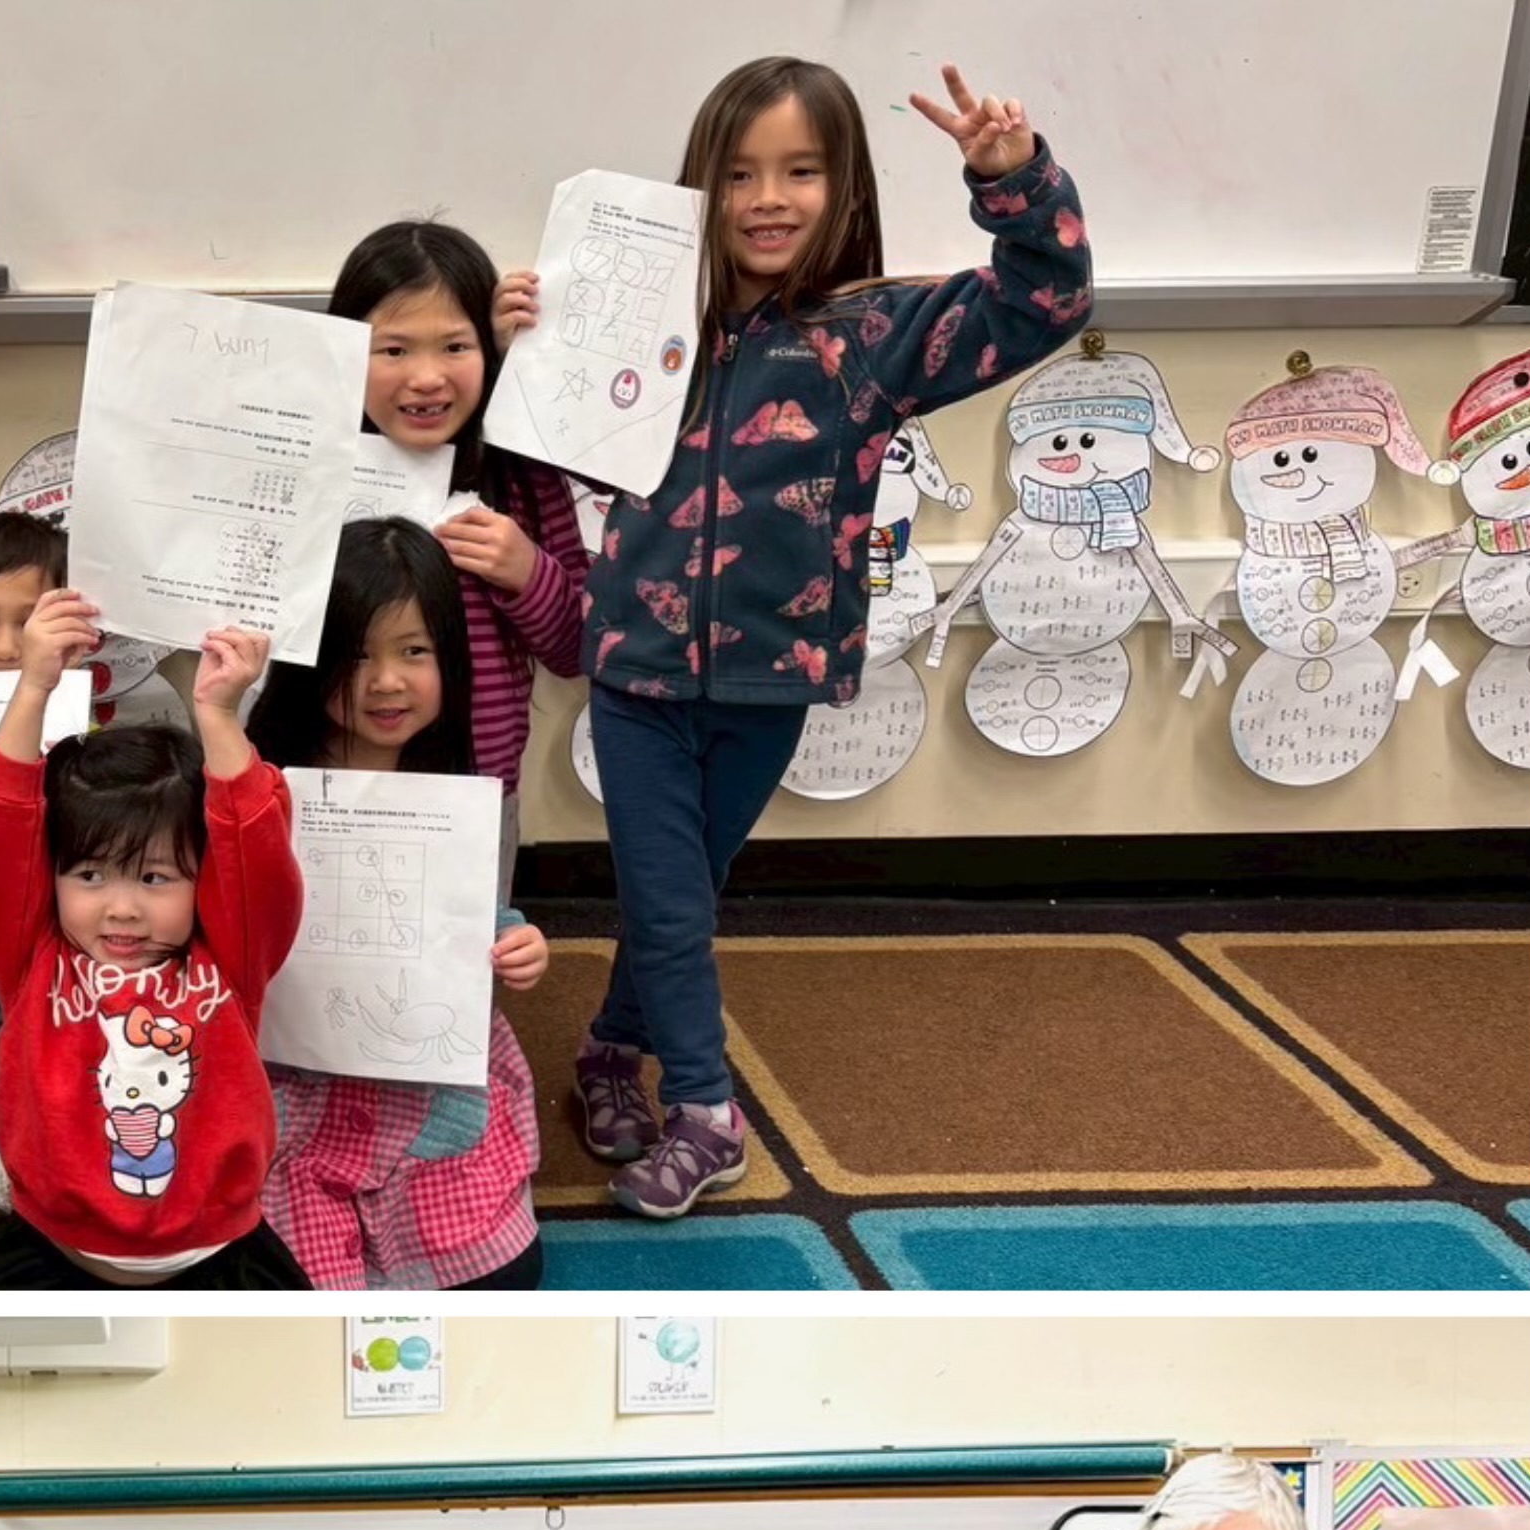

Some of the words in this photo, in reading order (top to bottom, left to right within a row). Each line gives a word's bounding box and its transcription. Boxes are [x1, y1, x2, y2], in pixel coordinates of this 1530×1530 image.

[1030, 403, 1071, 423] MATH
[1073, 402, 1149, 423] SNOWMAN
[1254, 418, 1299, 438] MATH
[1301, 417, 1384, 438] SNOWMAN
